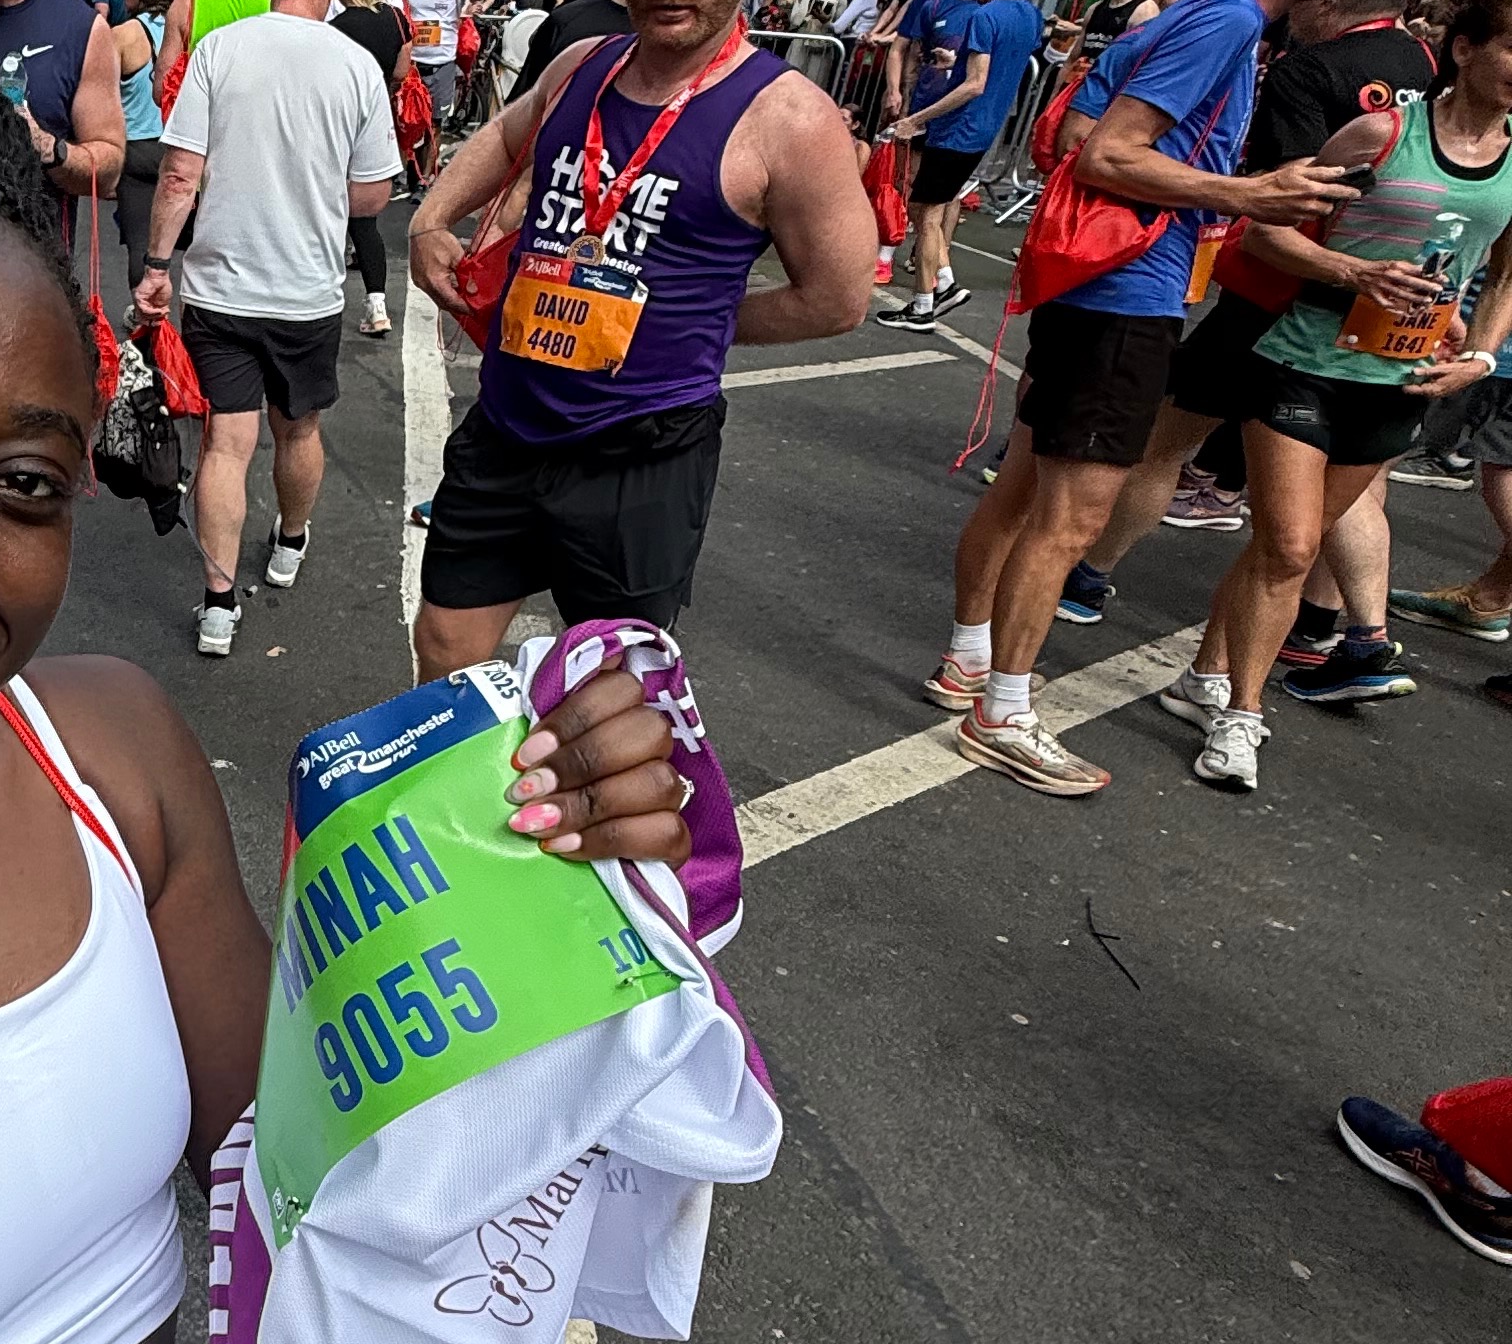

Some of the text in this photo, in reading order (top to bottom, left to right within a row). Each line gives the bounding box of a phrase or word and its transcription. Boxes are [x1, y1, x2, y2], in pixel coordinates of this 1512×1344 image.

[533, 292, 590, 326] DAVID
[527, 327, 577, 360] 4480
[310, 731, 362, 768] AJBell
[318, 707, 455, 790] great manchester
[392, 742, 418, 764] run
[313, 937, 499, 1113] 9055
